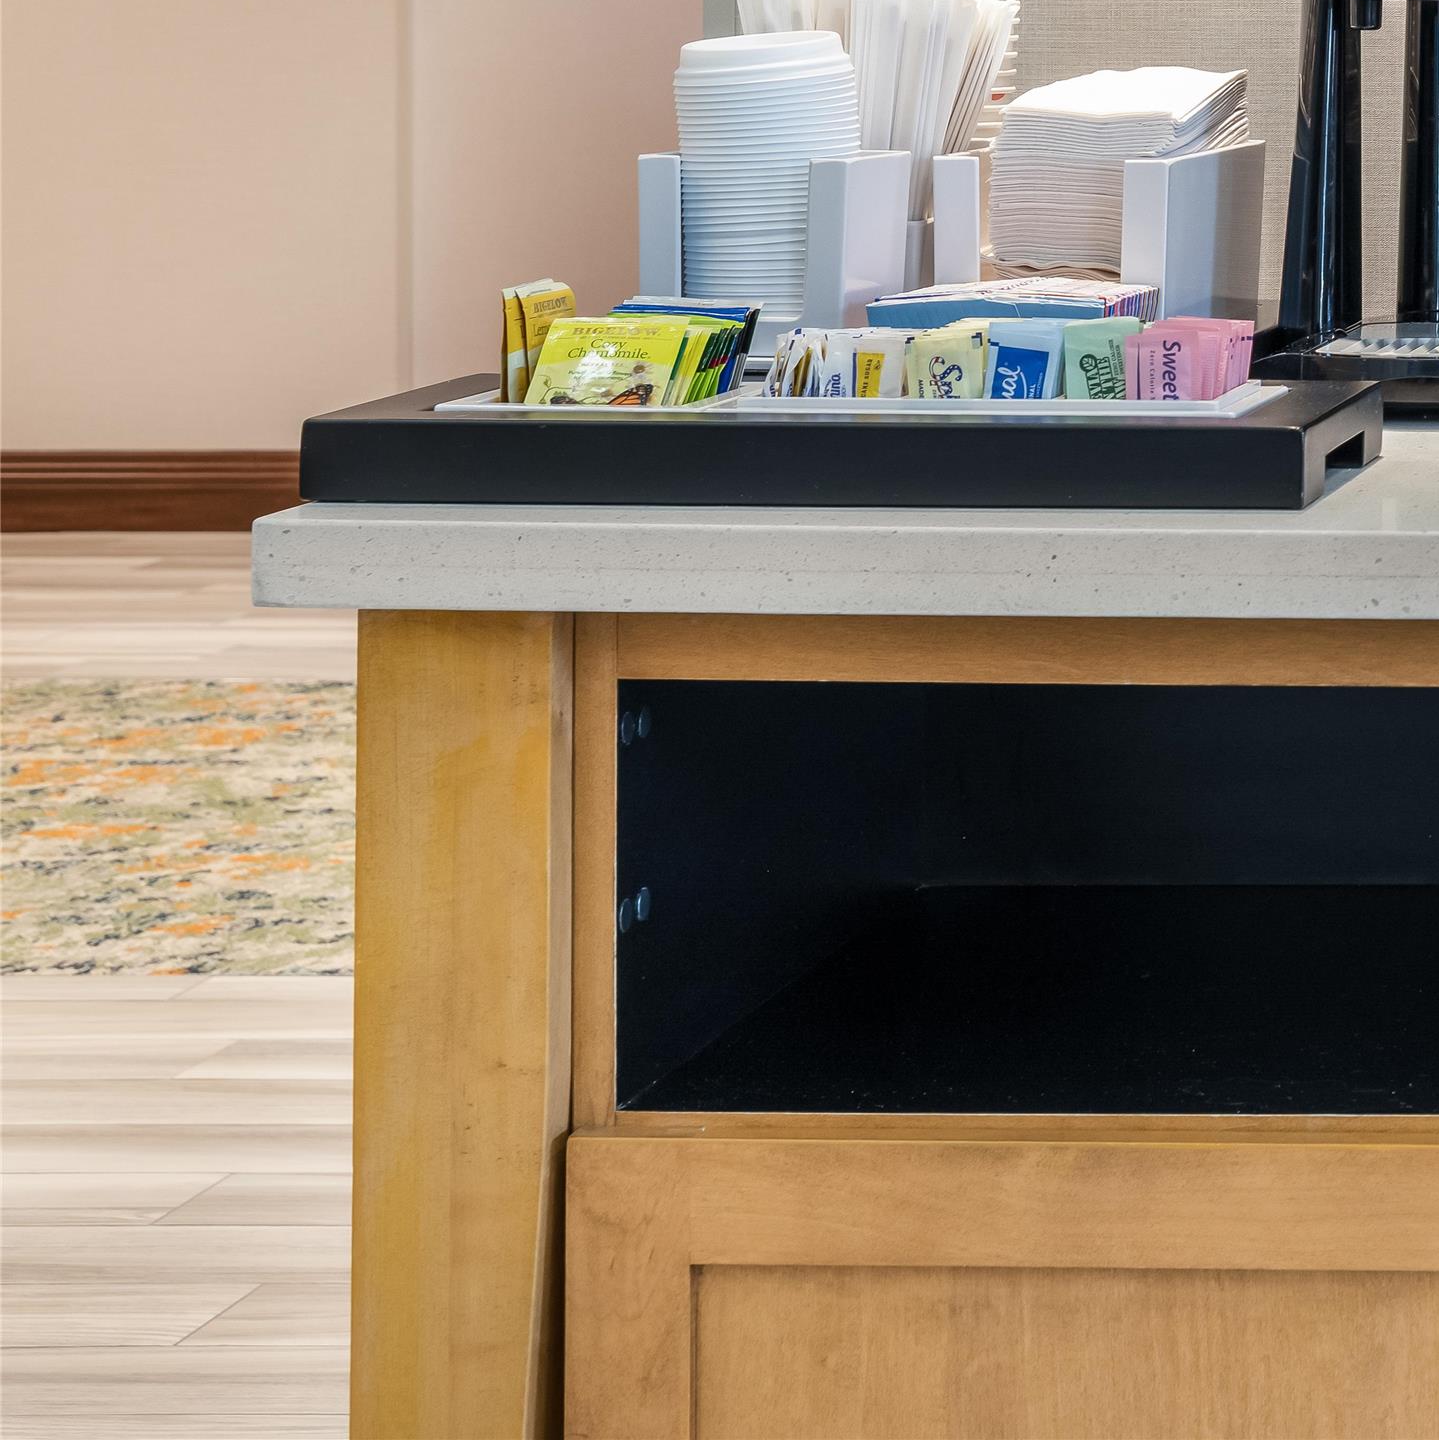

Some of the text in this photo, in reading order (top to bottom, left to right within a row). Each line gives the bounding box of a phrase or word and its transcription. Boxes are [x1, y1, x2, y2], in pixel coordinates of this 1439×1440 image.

[533, 296, 567, 314] BIGELOW
[573, 326, 658, 336] BIGELOW
[590, 338, 628, 350] Cozy
[1161, 340, 1182, 401] Sweet
